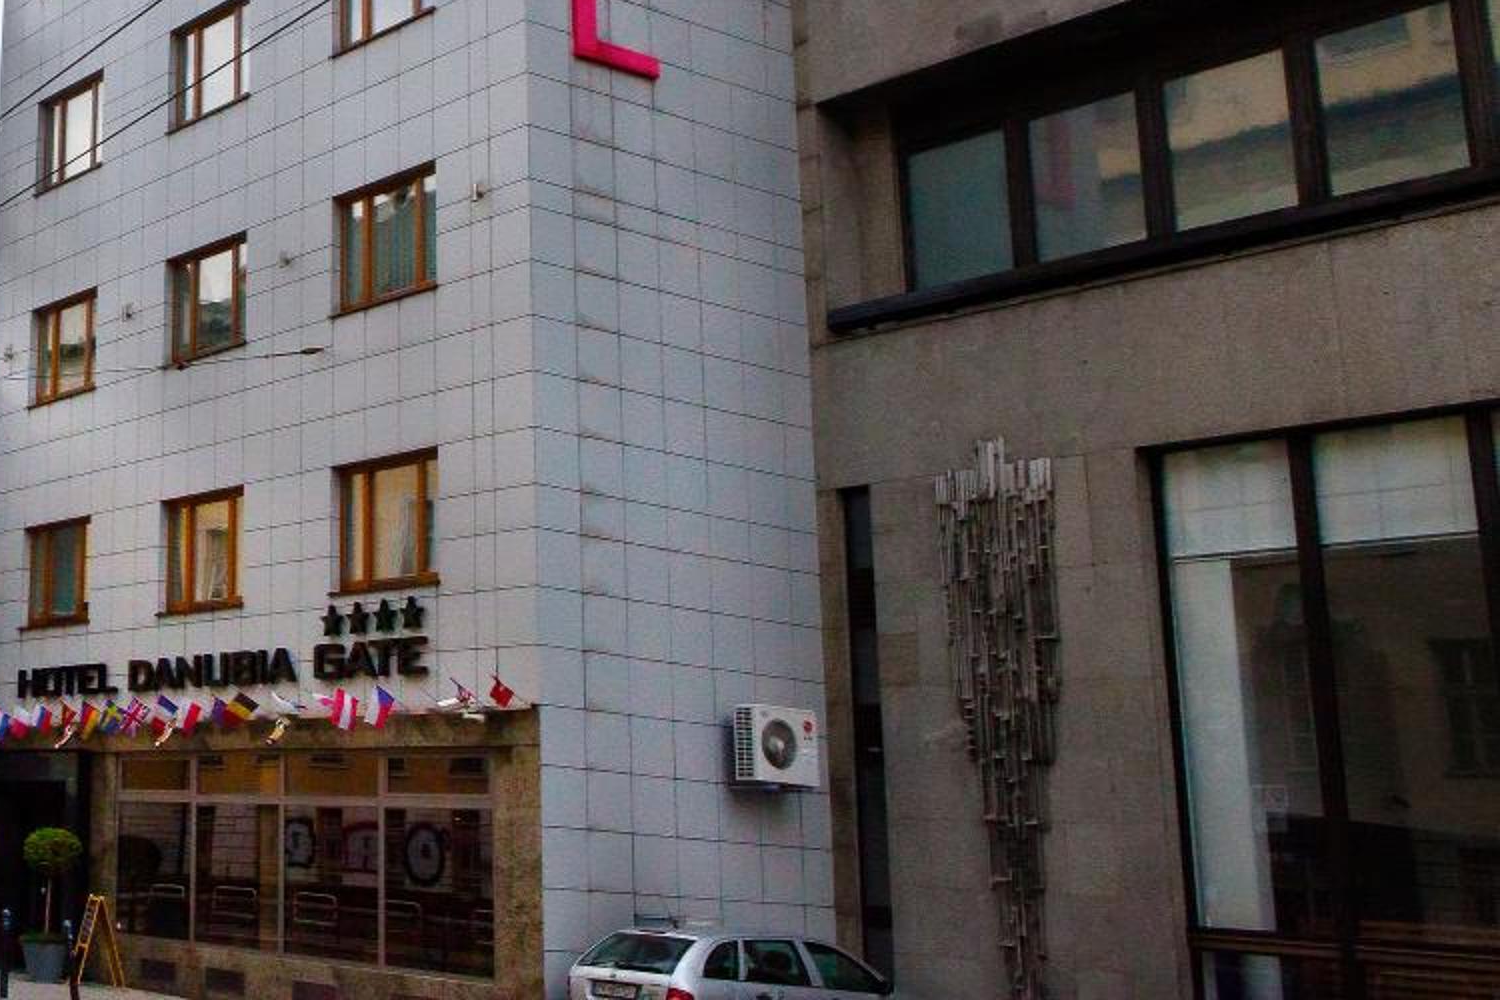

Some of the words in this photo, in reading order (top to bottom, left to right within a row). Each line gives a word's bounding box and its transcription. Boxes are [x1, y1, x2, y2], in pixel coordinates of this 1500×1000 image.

[17, 663, 118, 698] HOTEL
[128, 648, 297, 692] DANUBIA
[313, 635, 429, 680] GATE
